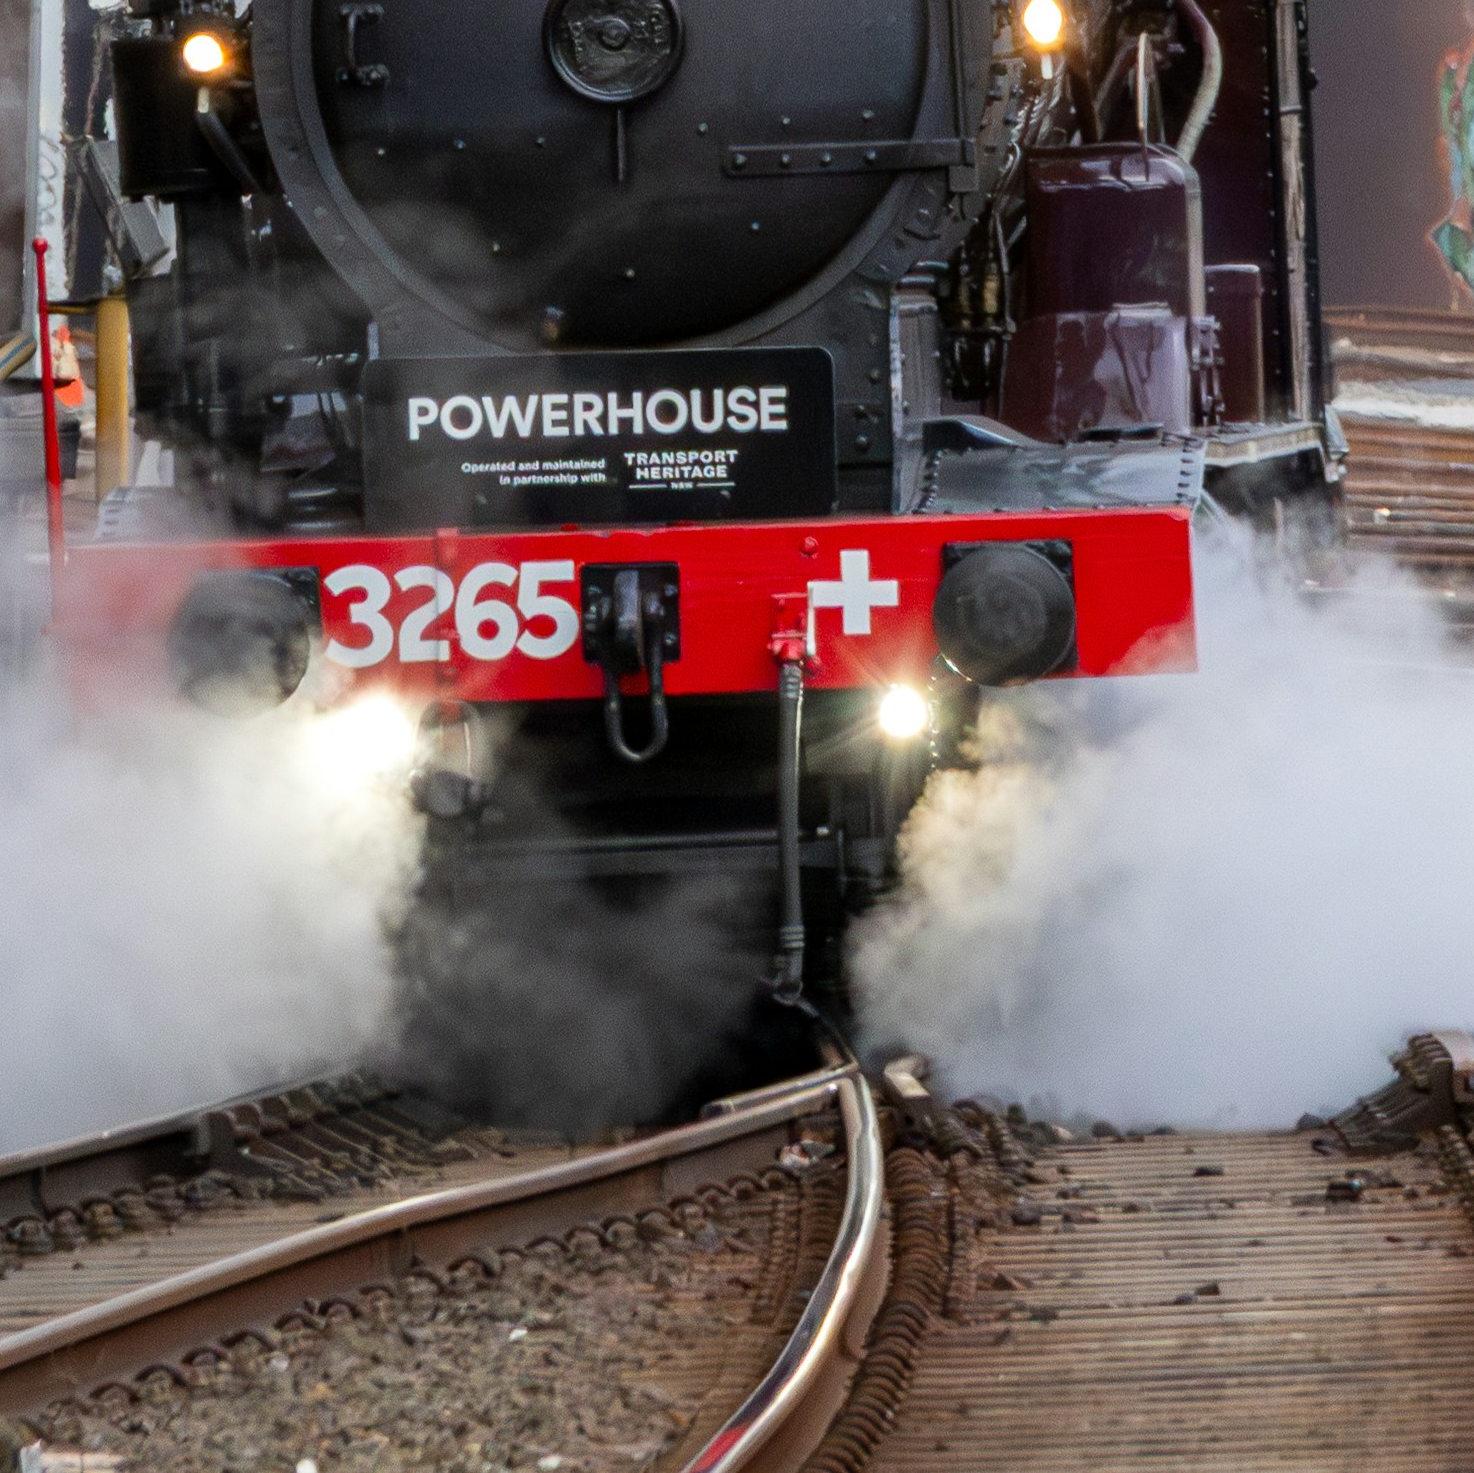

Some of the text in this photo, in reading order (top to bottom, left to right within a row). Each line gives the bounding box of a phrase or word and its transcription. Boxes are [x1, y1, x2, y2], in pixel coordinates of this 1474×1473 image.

[407, 385, 789, 441] POWERHOUSE
[623, 449, 739, 466] TRANSPORT
[460, 458, 606, 474] Operated and maintained
[635, 464, 729, 480] HERITAGE
[513, 473, 578, 488] partnership
[580, 472, 607, 483] with
[323, 559, 580, 669] 3265
